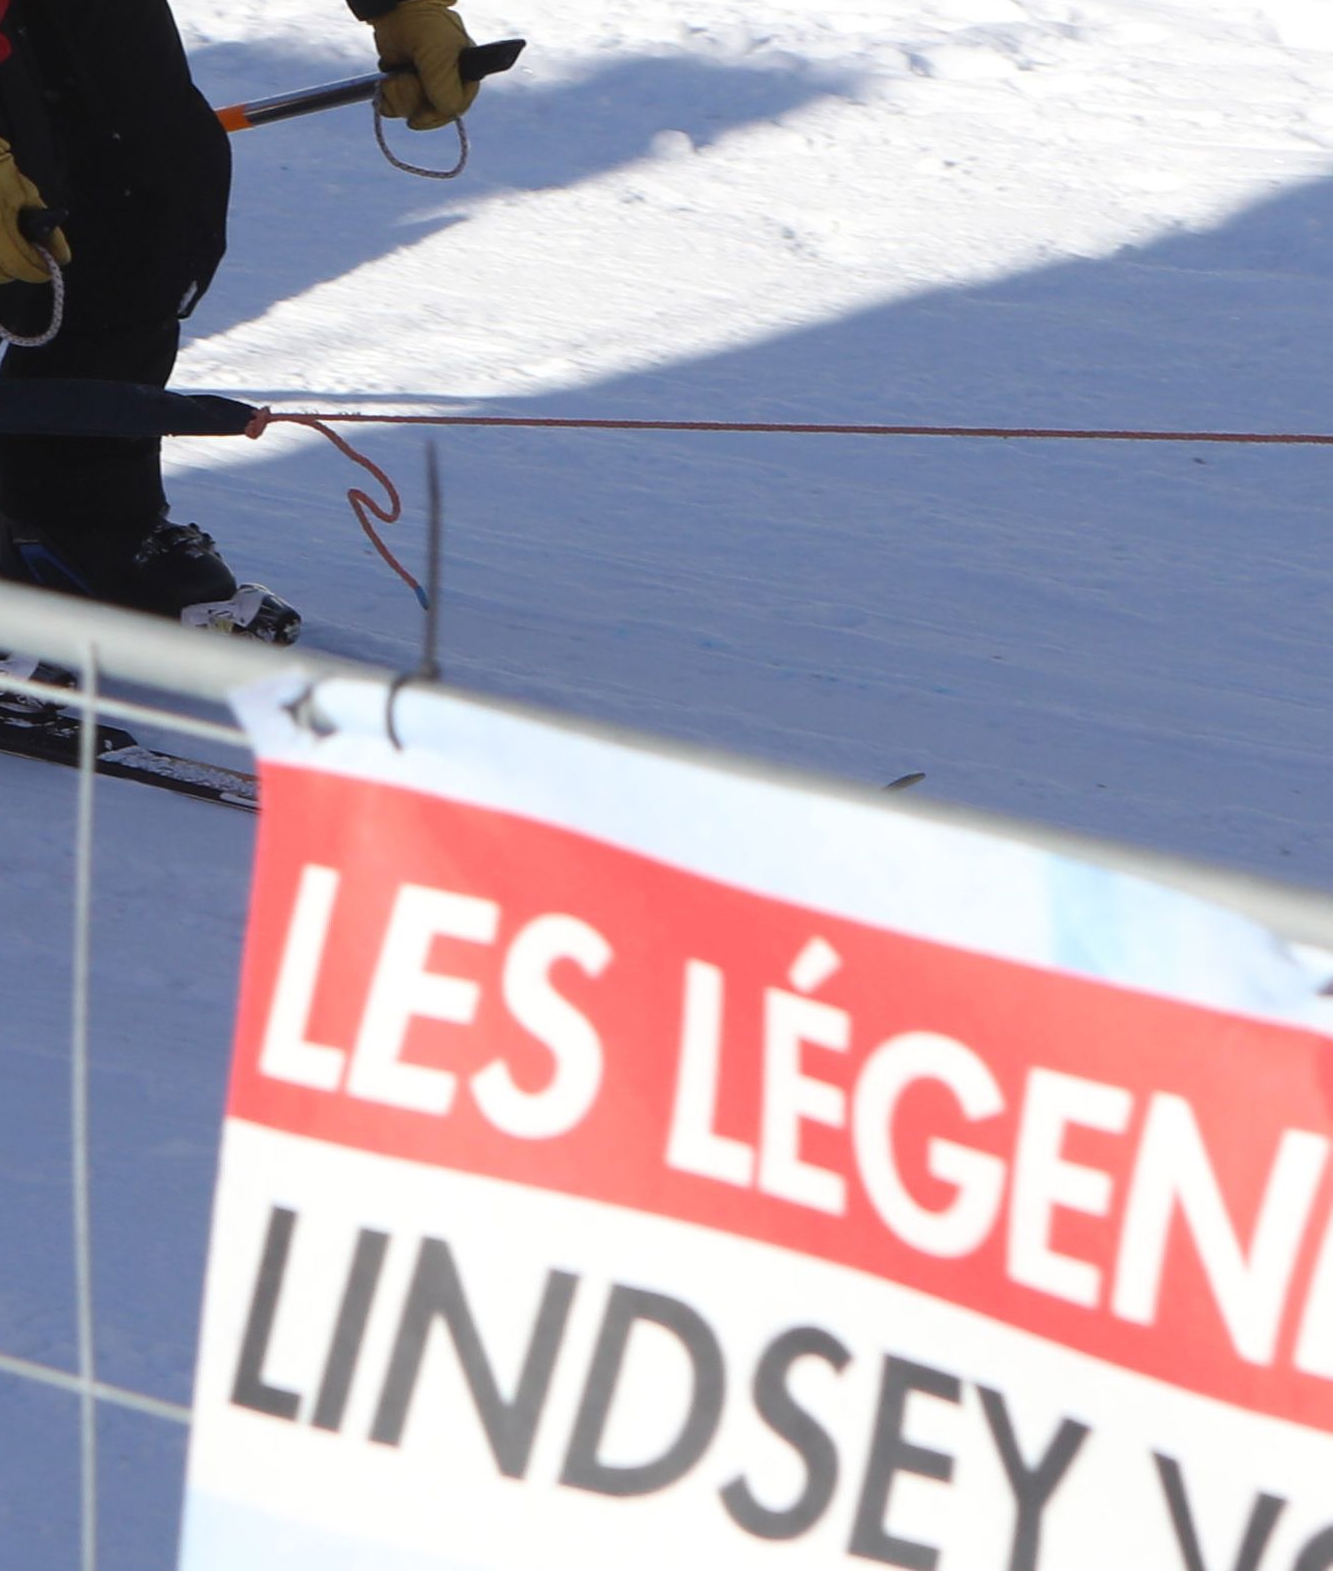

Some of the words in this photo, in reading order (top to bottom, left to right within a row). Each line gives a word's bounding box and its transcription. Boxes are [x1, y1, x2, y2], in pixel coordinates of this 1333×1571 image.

[257, 862, 614, 1142] LES
[664, 934, 1333, 1380] LÉGEN
[227, 1204, 1093, 1571] LINDSEY
[1151, 1446, 1333, 1571] V
